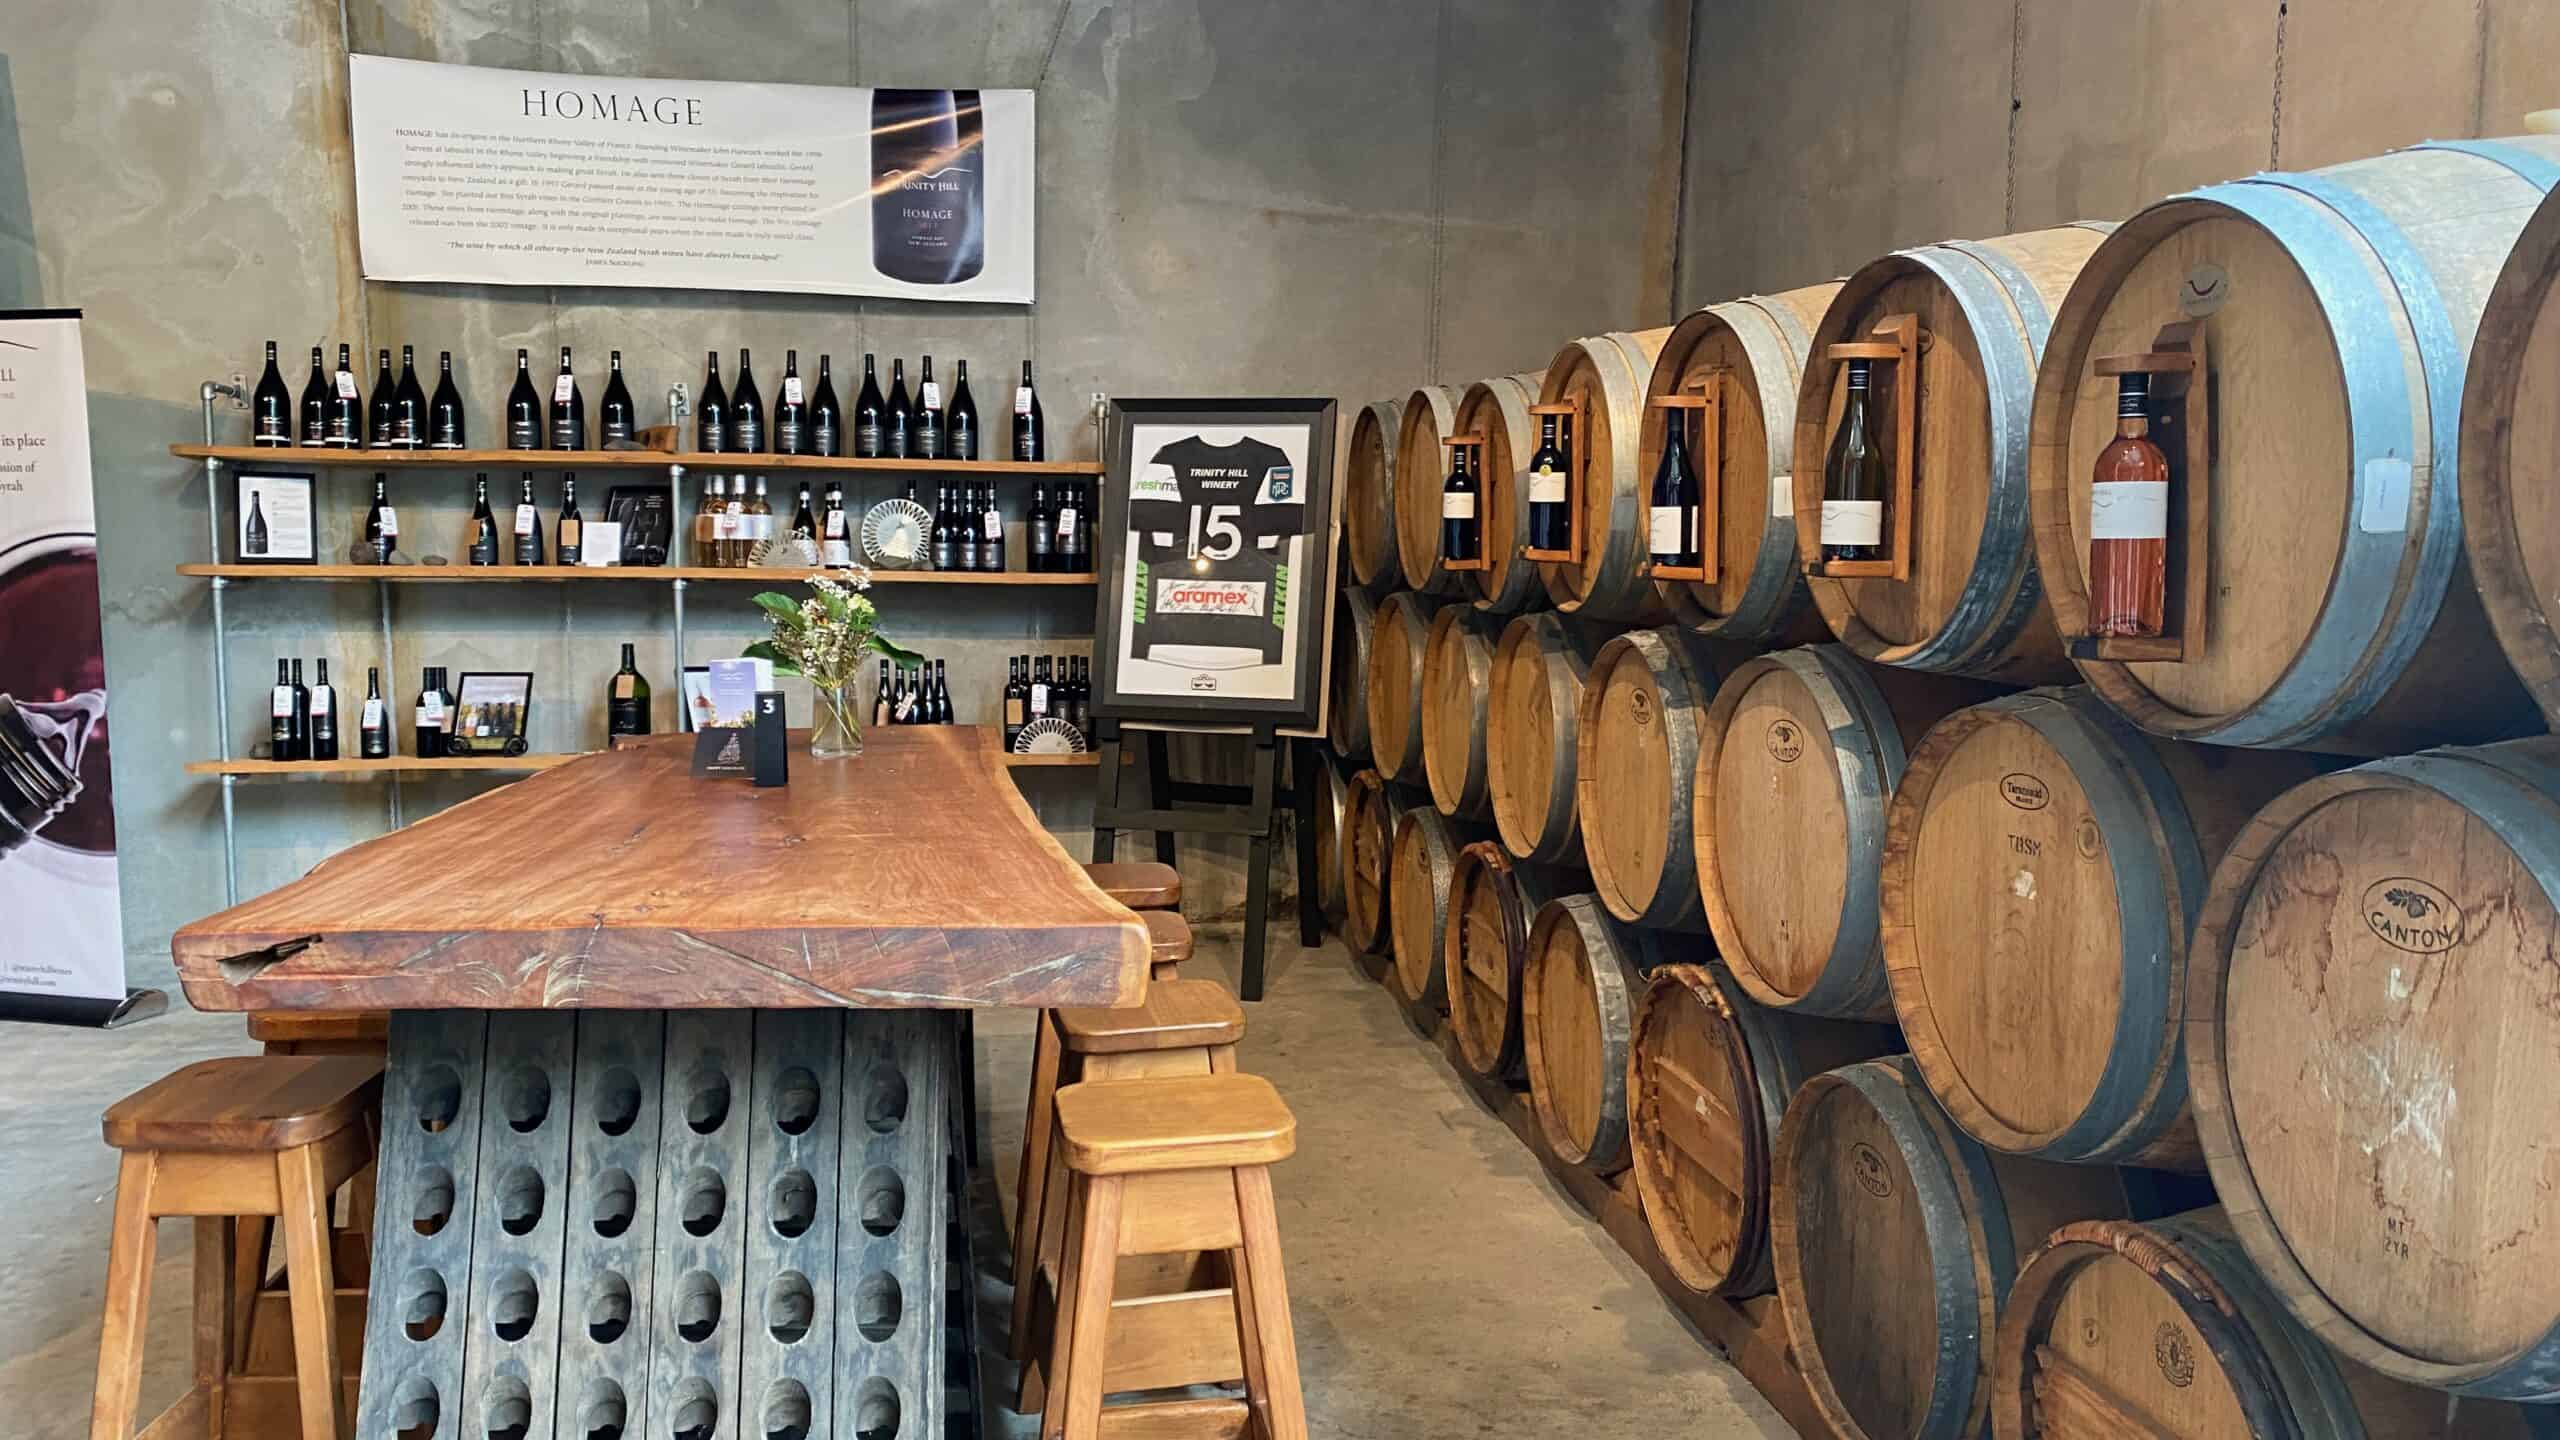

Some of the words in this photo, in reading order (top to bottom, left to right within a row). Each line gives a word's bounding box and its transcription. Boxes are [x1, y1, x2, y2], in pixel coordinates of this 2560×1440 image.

[520, 89, 702, 126] HOMAGE
[938, 182, 960, 191] HILL
[903, 208, 952, 219] HOMAGE
[1, 434, 15, 447] its
[17, 432, 46, 450] place
[25, 460, 35, 472] of
[1190, 468, 1226, 477] TRINITY
[1228, 469, 1248, 477] HILL
[1201, 481, 1239, 489] WINERY
[1187, 505, 1242, 560] 15
[1172, 590, 1248, 605] aramex
[762, 698, 775, 714] 3
[2371, 911, 2453, 948] CANTON
